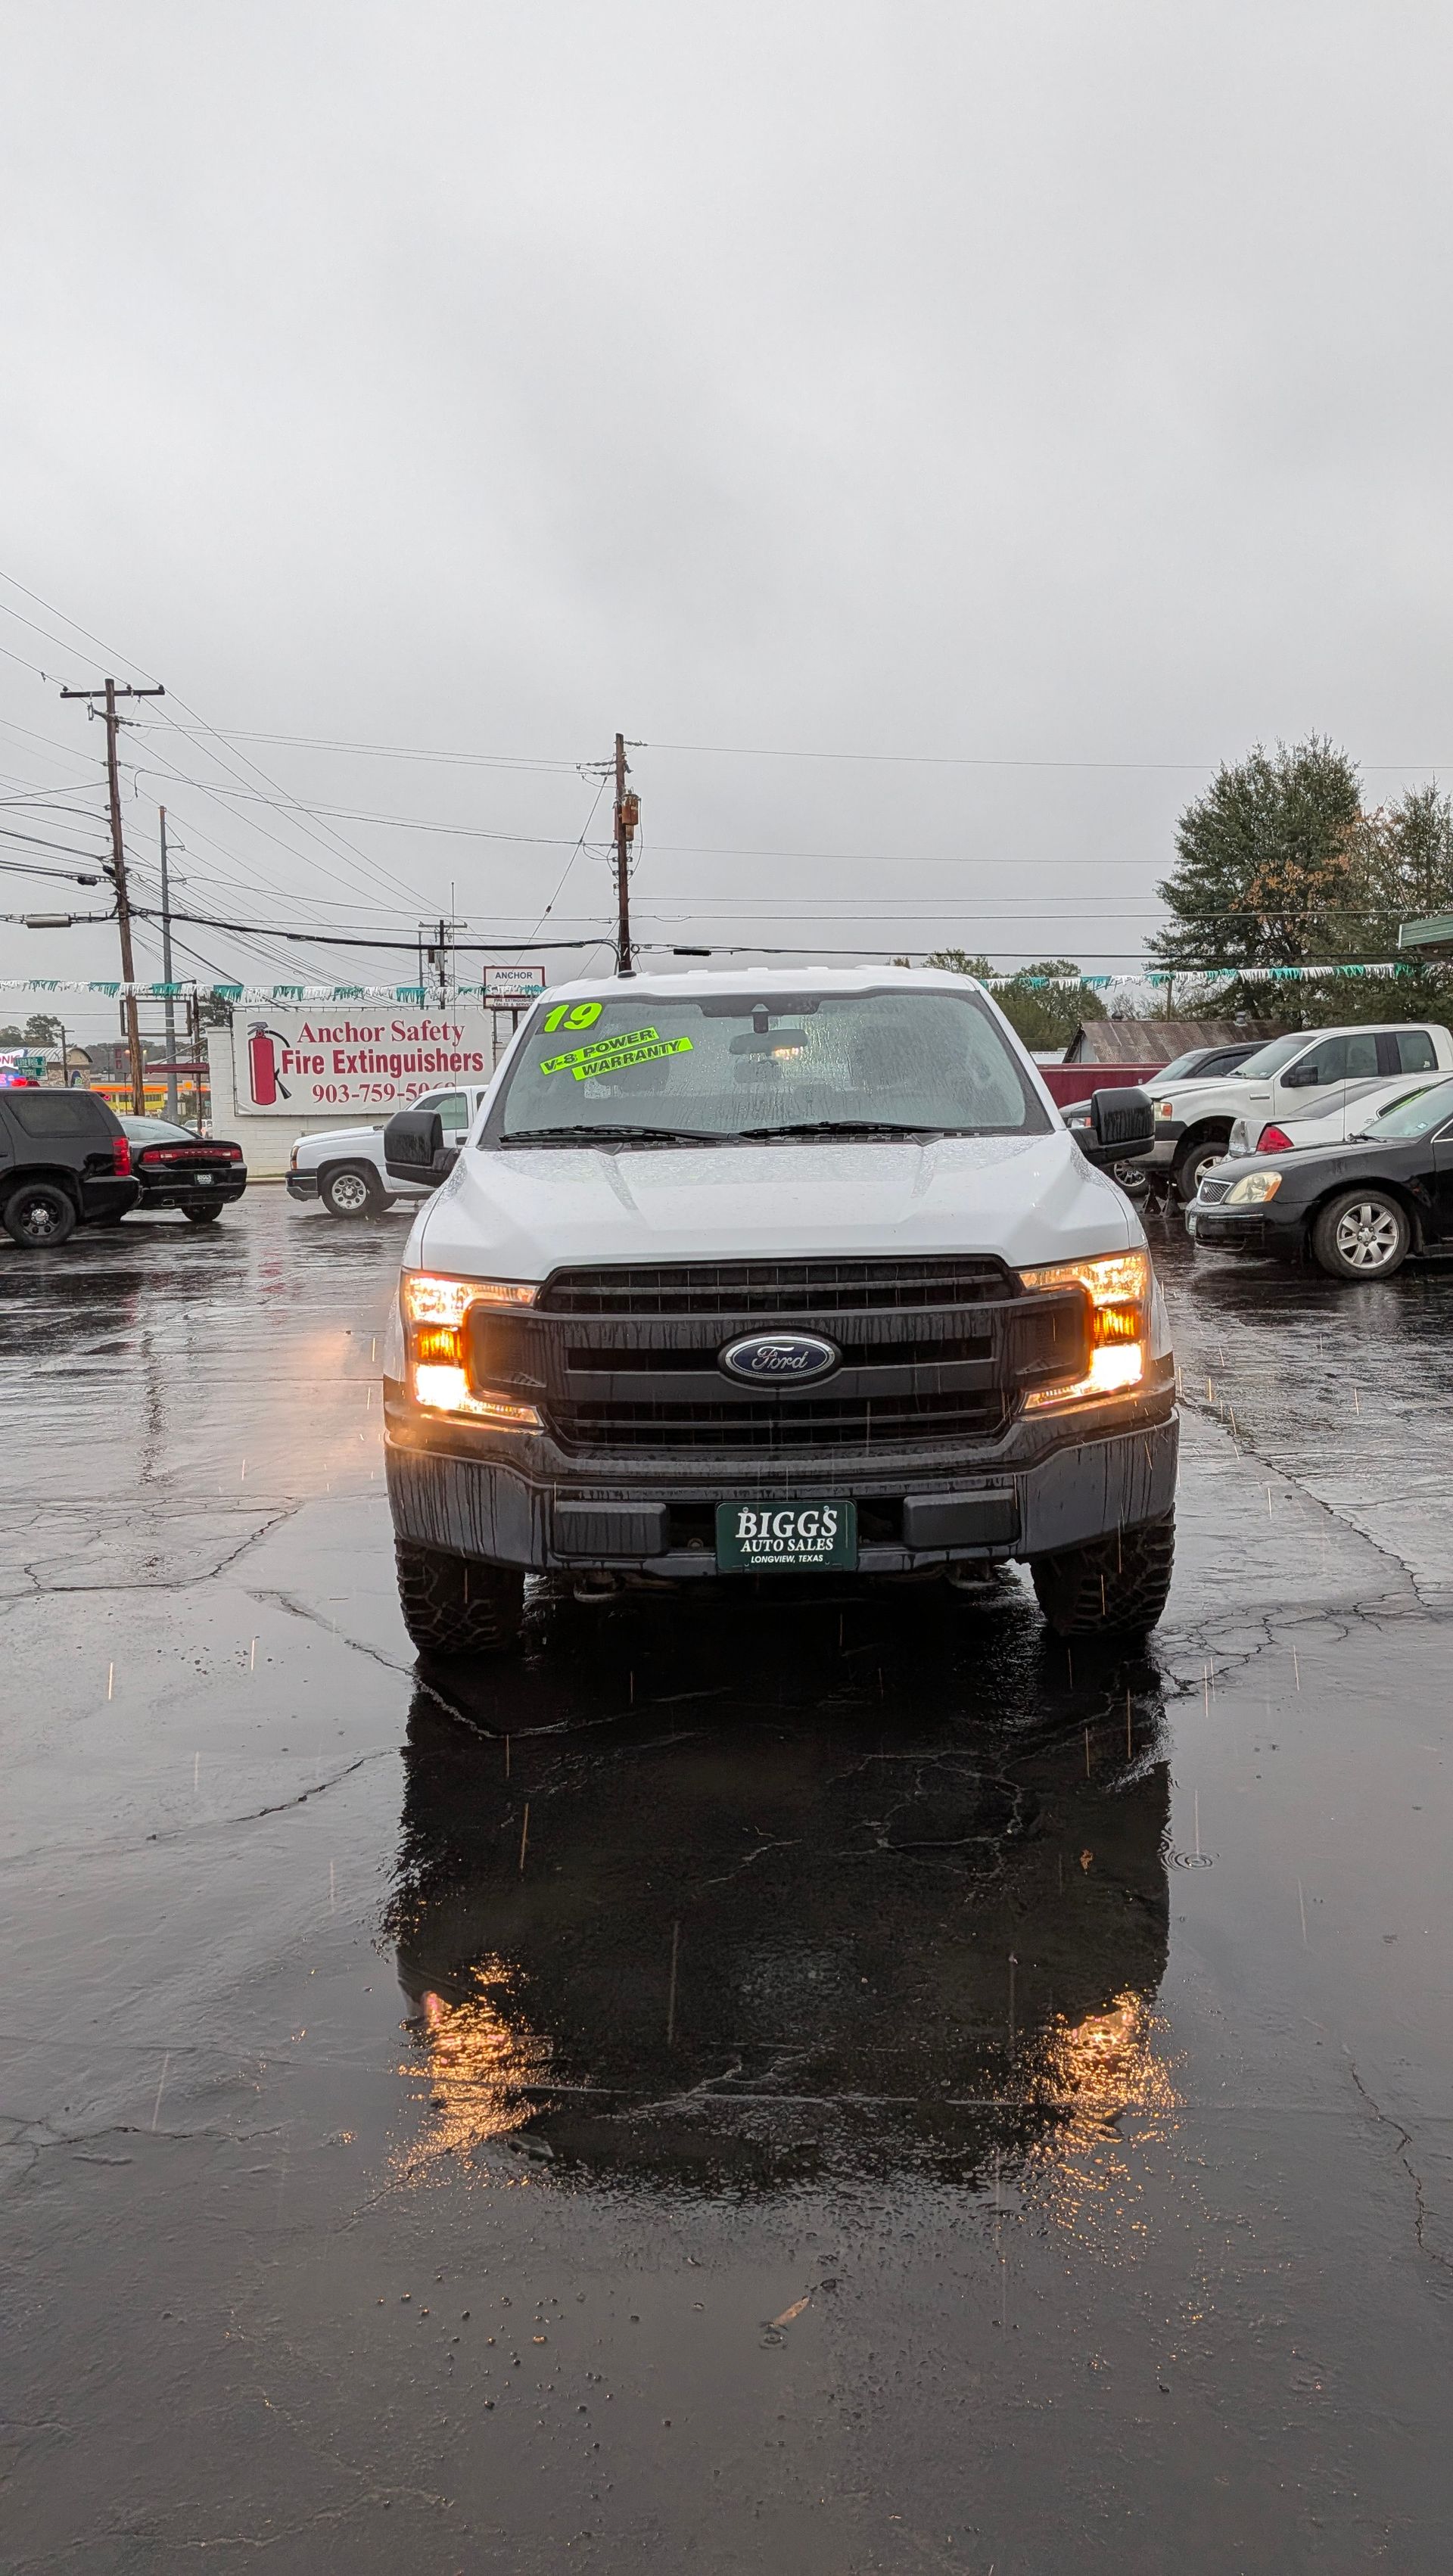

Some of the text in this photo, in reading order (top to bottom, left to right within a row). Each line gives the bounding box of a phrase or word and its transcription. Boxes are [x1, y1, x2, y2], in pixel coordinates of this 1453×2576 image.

[544, 1002, 602, 1033] 19
[297, 1019, 465, 1047] Anchor Safety
[282, 1048, 484, 1078] Fire Extinguishers
[544, 1029, 655, 1072] V-8 POWER
[582, 1040, 681, 1076] WARRANTY
[312, 1082, 456, 1103] 903-759-50
[751, 1346, 808, 1370] Ford
[735, 1510, 838, 1538] BIGGS
[740, 1538, 833, 1552] AUTO SALES
[751, 1554, 823, 1564] LONGVIEW, TEXAS
